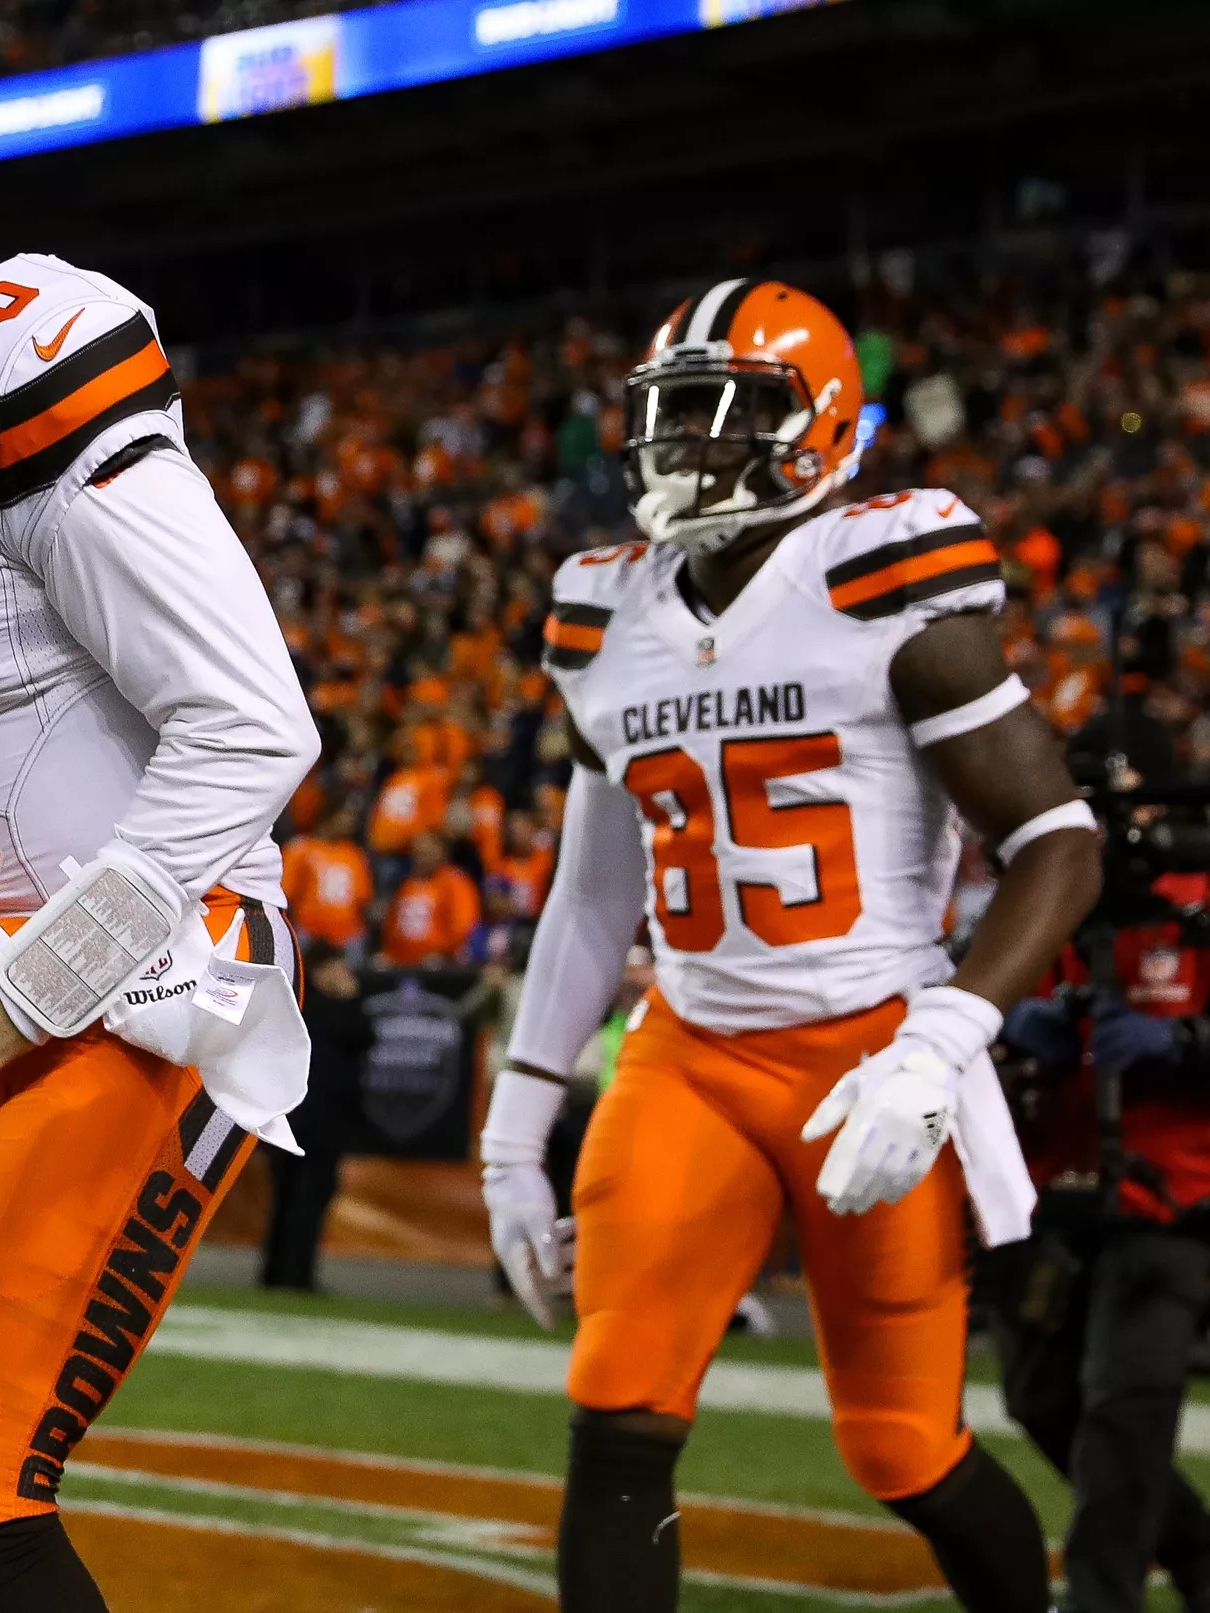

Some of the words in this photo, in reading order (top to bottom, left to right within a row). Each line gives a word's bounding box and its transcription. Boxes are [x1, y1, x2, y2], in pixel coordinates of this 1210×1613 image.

[623, 682, 805, 743] CLEVELAND
[624, 732, 862, 952] 85
[124, 979, 197, 1005] Wilson
